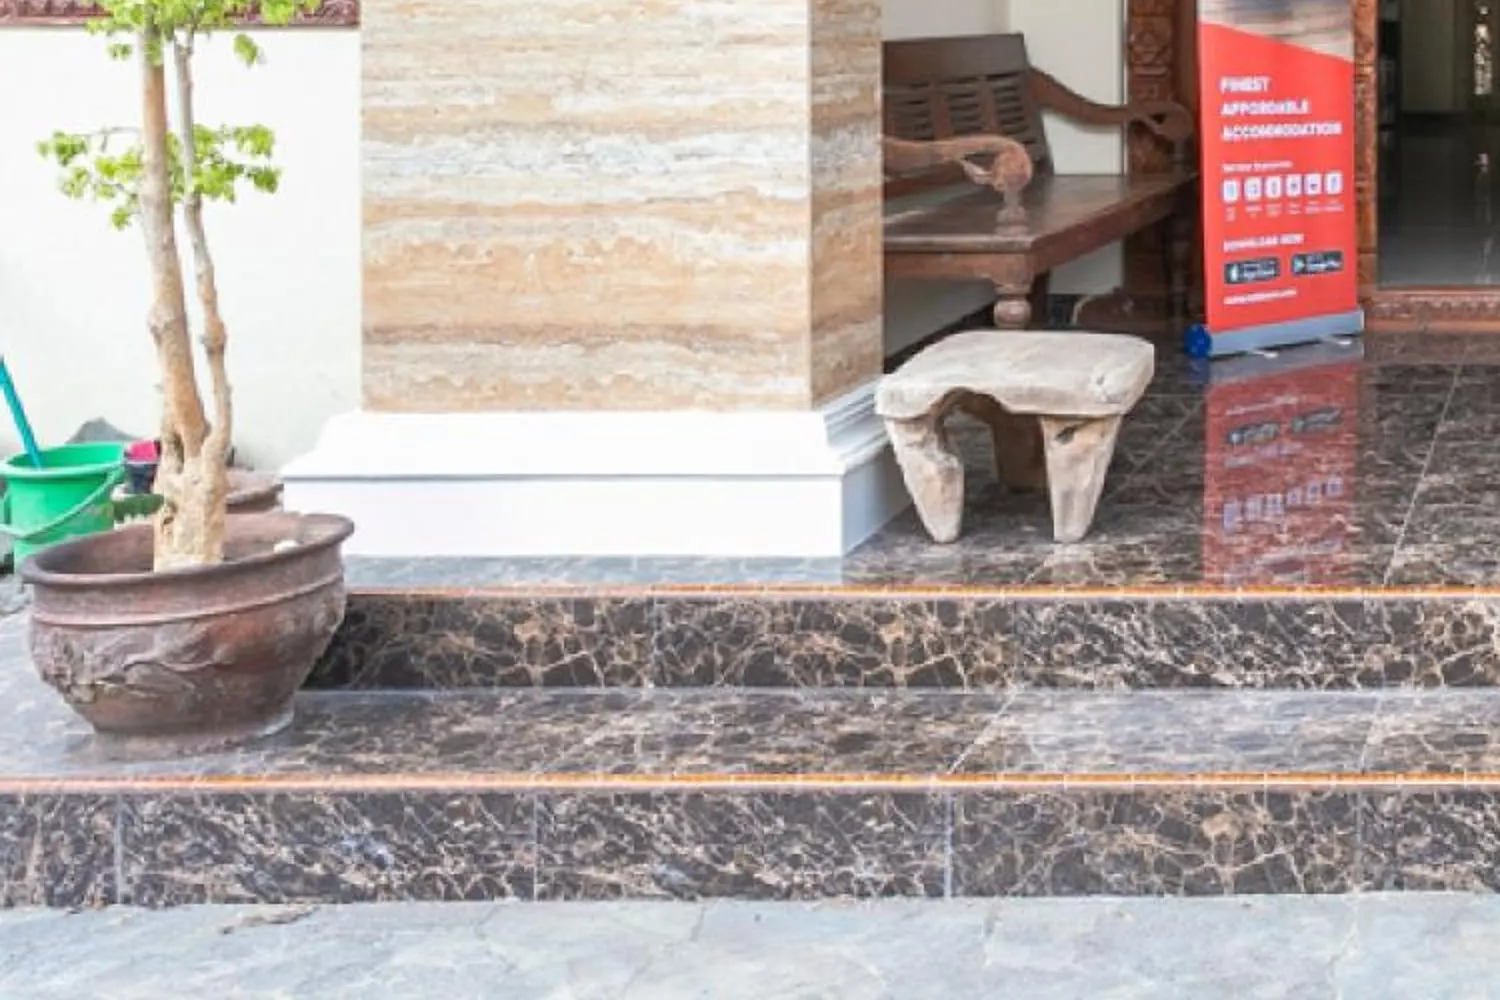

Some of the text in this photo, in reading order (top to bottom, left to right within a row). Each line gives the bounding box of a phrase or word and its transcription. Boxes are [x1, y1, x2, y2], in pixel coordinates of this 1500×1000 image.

[1220, 75, 1271, 94] FINEST
[1220, 98, 1310, 116] AFFORDABLE
[1220, 121, 1343, 142] ACCOMMODATION
